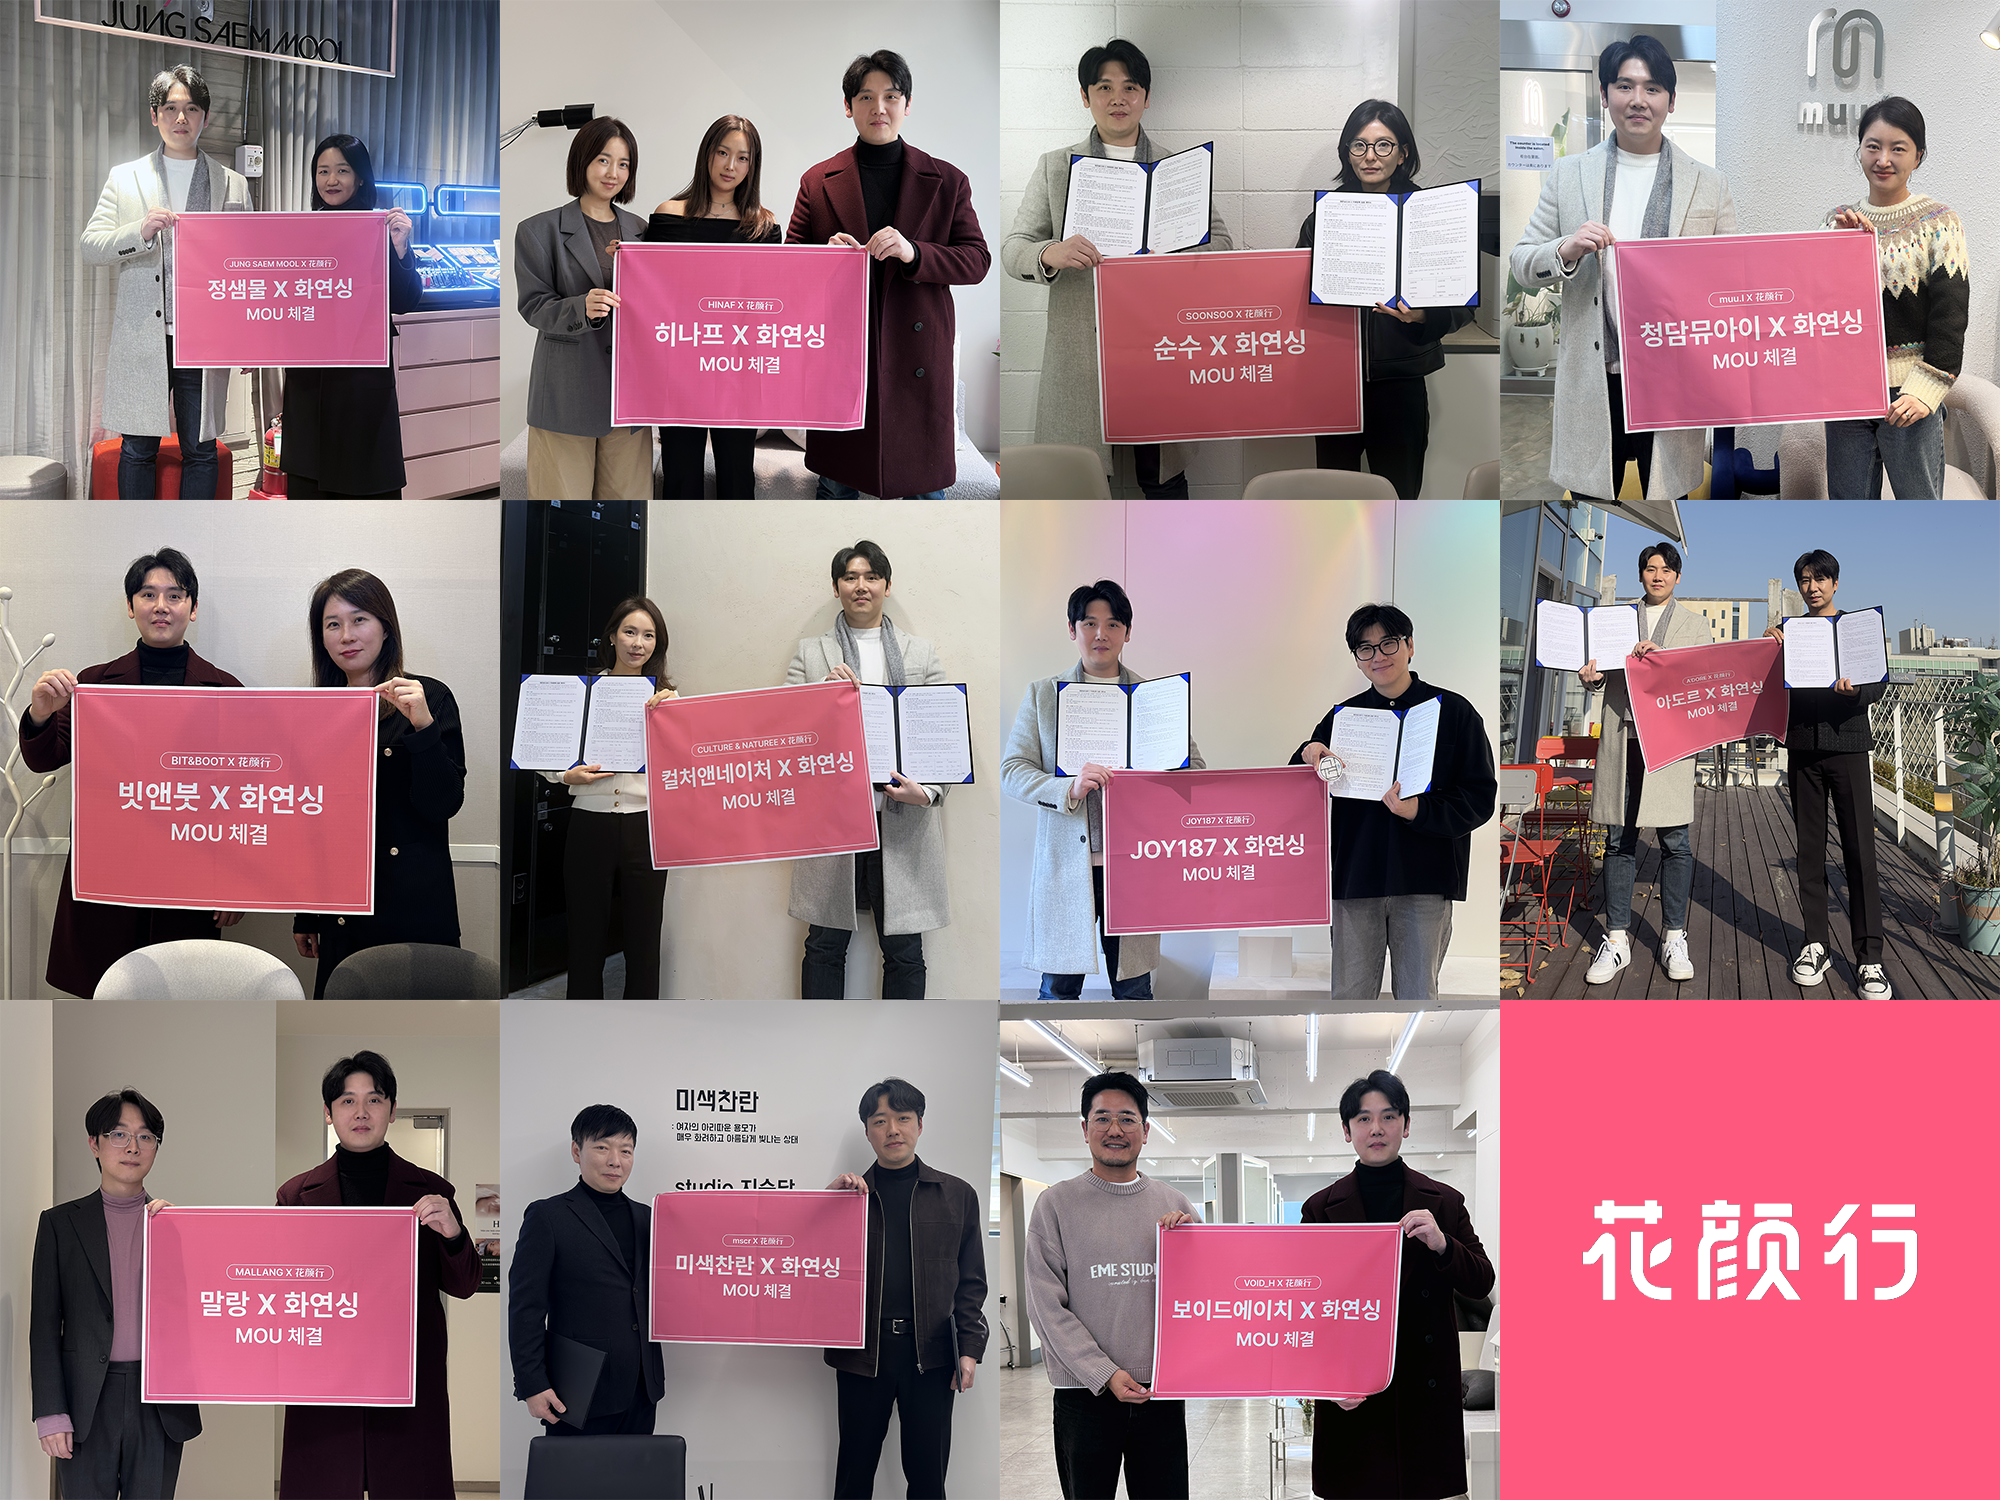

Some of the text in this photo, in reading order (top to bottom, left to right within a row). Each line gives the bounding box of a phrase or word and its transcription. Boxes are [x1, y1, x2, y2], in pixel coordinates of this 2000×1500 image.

[101, 0, 350, 65] JUNG SAEM MOOL
[208, 278, 352, 300] 정샘물 X 화연싱
[247, 306, 315, 321] MOU 체결
[738, 301, 743, 309] X
[1186, 311, 1233, 320] SOONSOO
[655, 322, 825, 348] 히나프 X 화연싱
[1640, 309, 1862, 347] 청담뮤아이 X 화연싱
[1154, 329, 1305, 360] 순수 X 화연싱
[700, 356, 780, 374] MOU 체결
[1713, 347, 1797, 369] MOU 체결
[1190, 364, 1273, 384] MOU 체결
[1657, 681, 1763, 709] 아도르 X 화연싱
[1688, 701, 1737, 719] MOU 체결
[697, 743, 733, 754] CULTURE
[742, 738, 778, 749] NATUREE
[172, 756, 225, 766] BIT&BOOT
[228, 757, 235, 766] X
[662, 751, 854, 790] 컬처앤네이처 X 화연싱
[119, 781, 323, 815] 빗앤붓 X 화연싱
[723, 788, 795, 810] MOU 체결
[1186, 817, 1216, 825] JOY187
[171, 823, 267, 845] MOU 체결
[1130, 834, 1304, 859] JOY187 X 화연싱
[1183, 864, 1255, 881] MOU 체결
[676, 1089, 759, 1113] 미색찬란
[676, 1122, 698, 1131] 여자의
[702, 1122, 731, 1132] 아리따운
[734, 1124, 756, 1132] 용모가
[676, 1133, 799, 1144] 매우 화려하고 아름답게 빛나는 상태
[236, 1268, 283, 1276] MALLANG
[676, 1254, 840, 1278] 미색찬란 X 화연싱
[1090, 1264, 1118, 1278] EME
[723, 1284, 791, 1299] MOU 체결
[1244, 1279, 1275, 1287] VOID_H
[201, 1291, 357, 1318] 말랑 X 화연싱
[1172, 1299, 1380, 1321] 보이드에이치 X 화연싱
[236, 1327, 322, 1346] MOU 체결
[1237, 1331, 1314, 1348] MOU 체결
